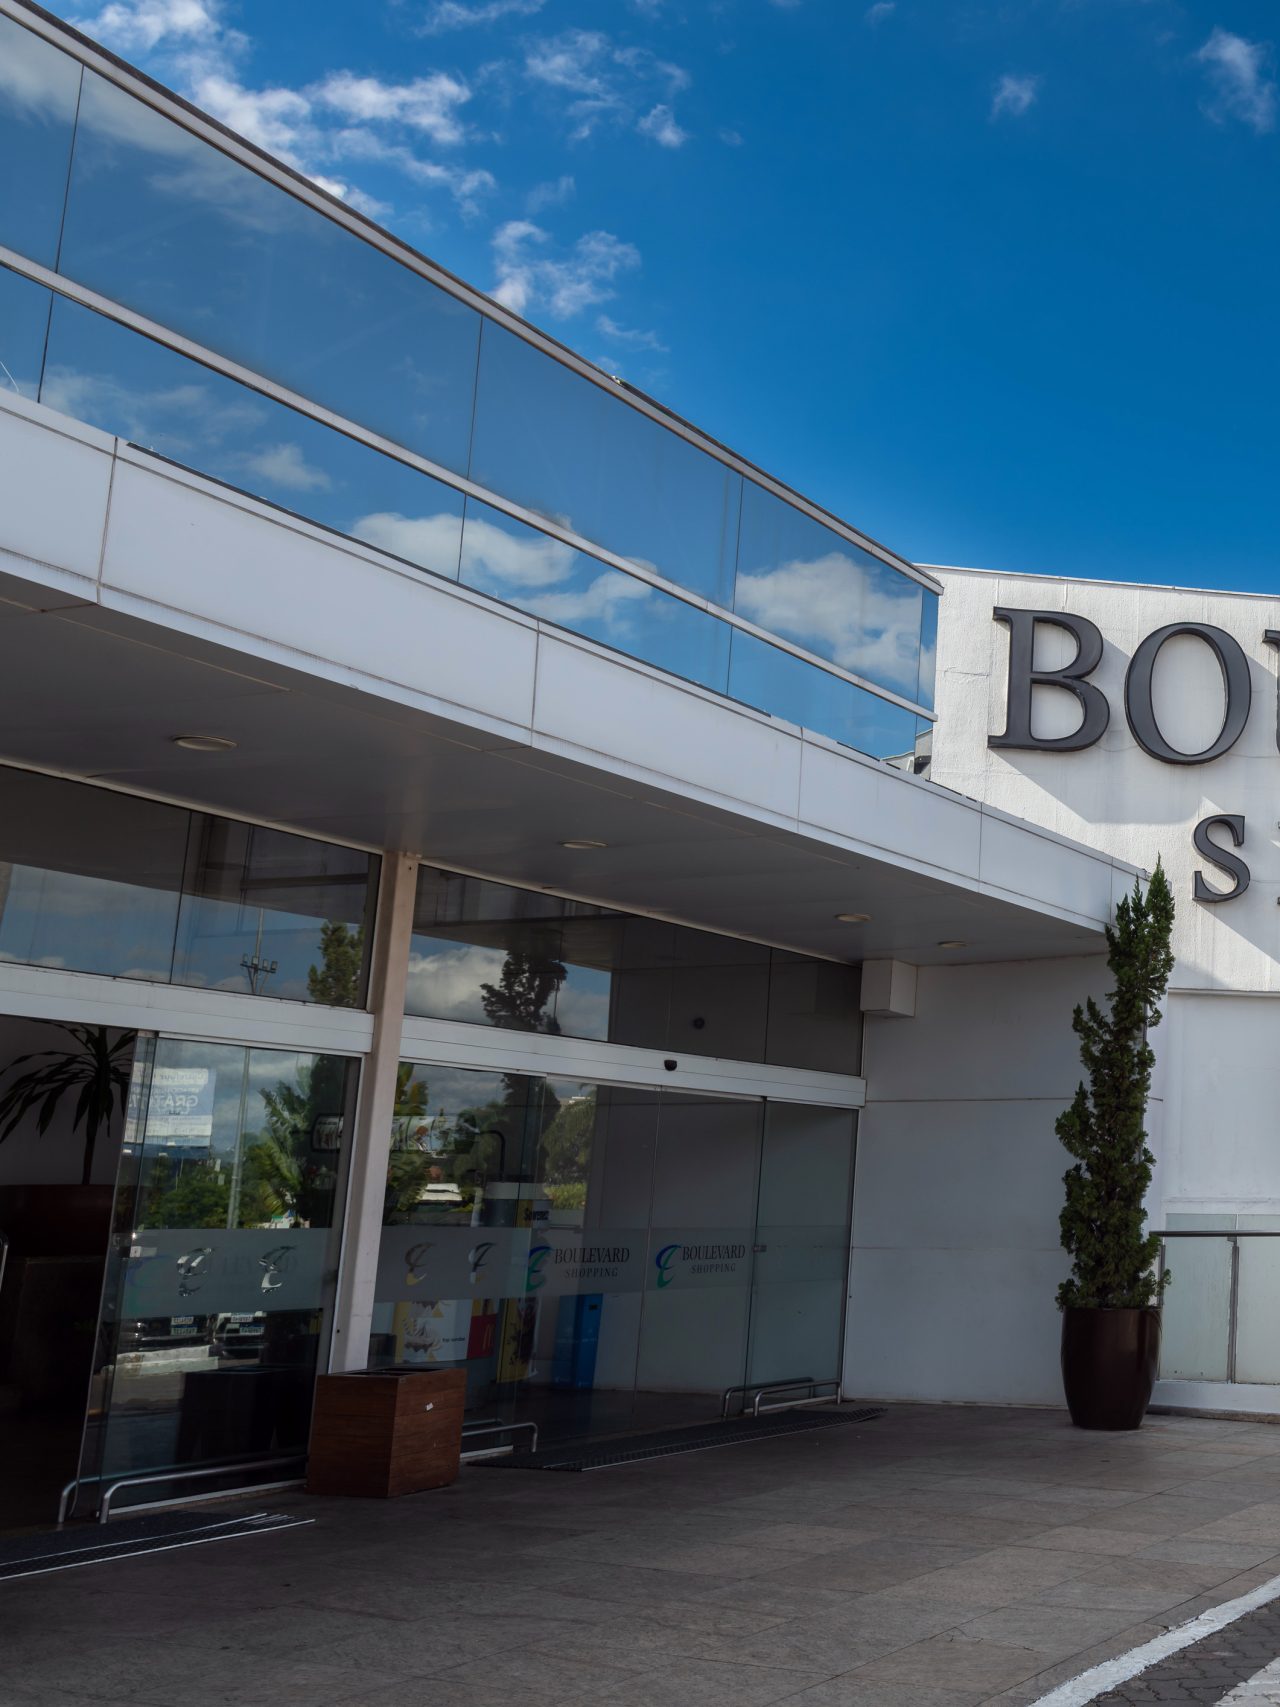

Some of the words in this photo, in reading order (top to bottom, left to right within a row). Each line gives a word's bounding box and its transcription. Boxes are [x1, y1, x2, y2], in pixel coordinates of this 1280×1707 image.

[554, 1247, 630, 1264] BOULEVARD
[682, 1244, 746, 1261] BOULEVARD
[564, 1267, 618, 1280] SHOPPING
[690, 1263, 736, 1275] SHOPPING
